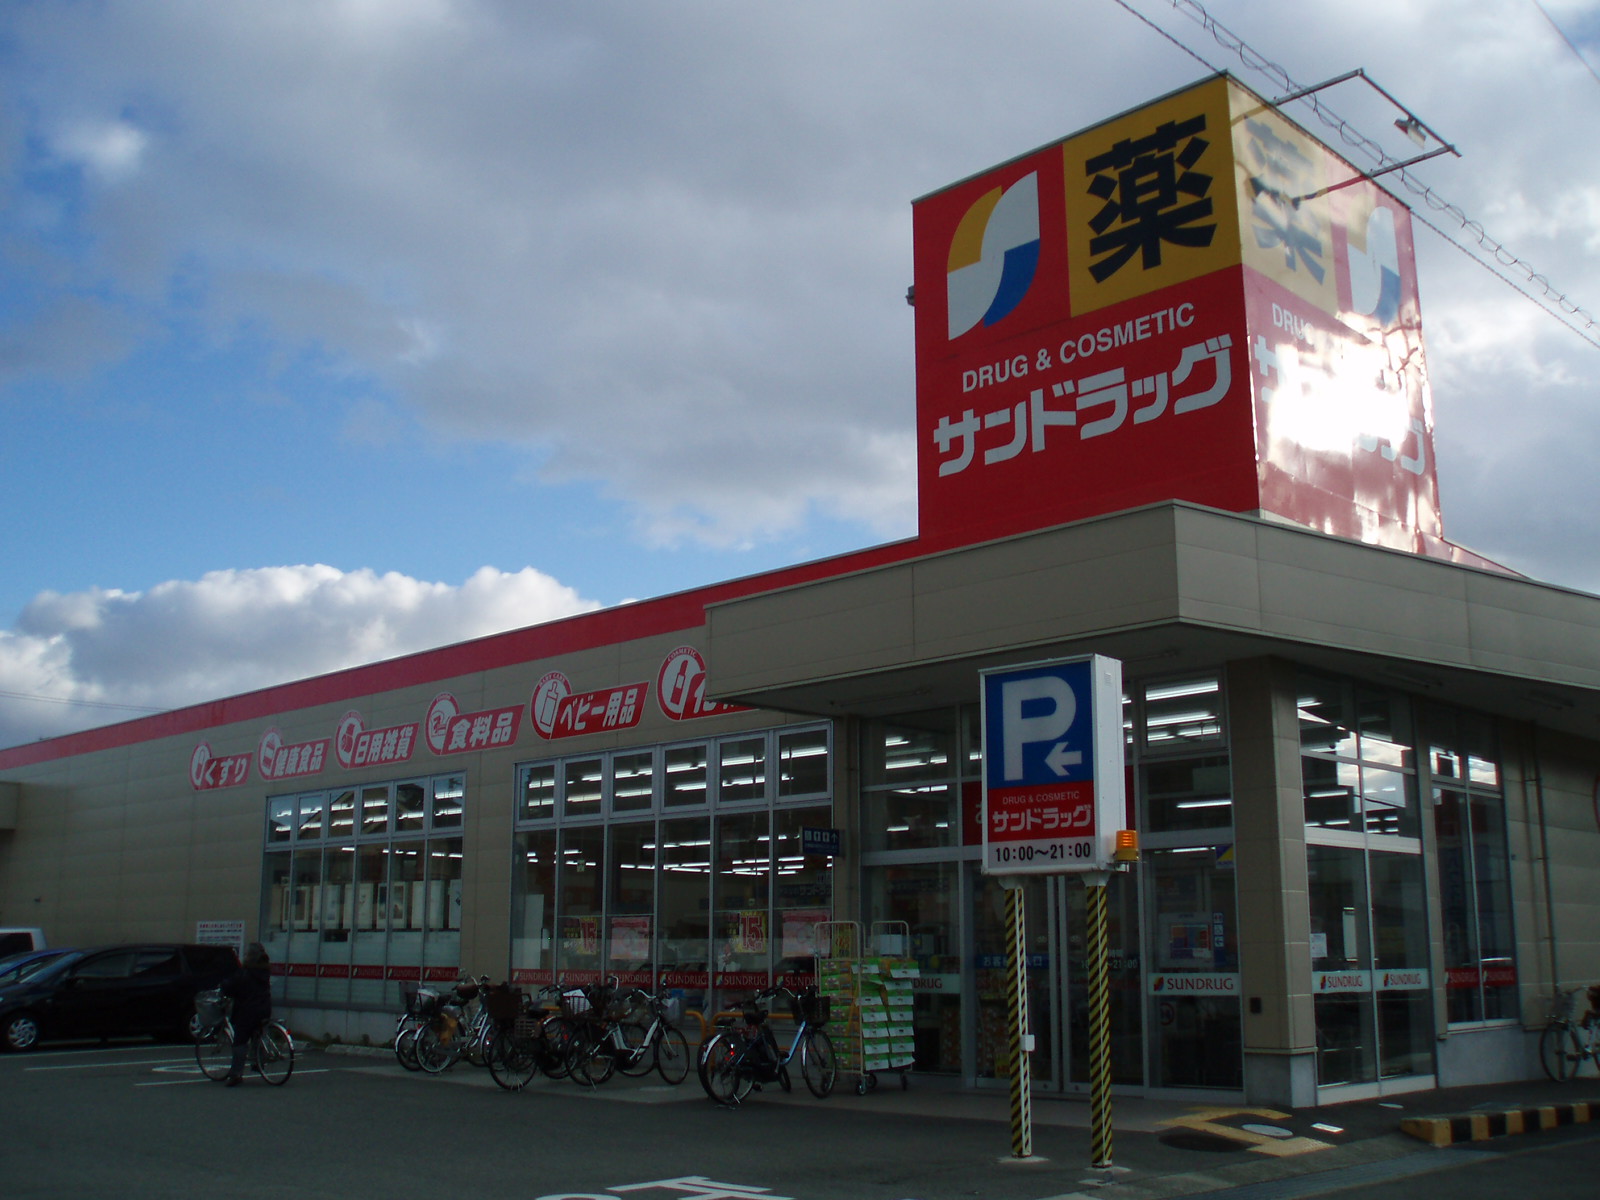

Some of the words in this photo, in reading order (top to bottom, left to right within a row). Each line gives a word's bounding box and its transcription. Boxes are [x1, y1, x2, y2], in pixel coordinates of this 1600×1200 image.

[1085, 114, 1217, 284] 薬
[962, 354, 1029, 393] DRUG
[1035, 347, 1052, 371] &
[1059, 302, 1195, 364] COSMETIC
[933, 333, 1233, 478] サンドラッグ
[560, 688, 638, 730] ベビー用品
[448, 712, 513, 750] 食料品
[1002, 675, 1077, 781] P
[355, 726, 414, 764] 日用雑貨
[205, 758, 247, 785] くすり
[274, 743, 324, 776] 健康食品
[1002, 795, 1026, 805] DRUG
[1036, 790, 1080, 802] COSMETIC
[992, 804, 1092, 833] サンドラッグ
[519, 971, 551, 982] SUNDRUG
[616, 973, 651, 984] UNDRUG
[667, 973, 708, 985] SUNDRUG
[723, 974, 767, 986] SUNDRUG
[913, 977, 943, 989] DRUG
[1167, 978, 1234, 990] SUNDRUG
[1328, 975, 1363, 988] SUNDRUG
[1390, 973, 1422, 986] SUNDRUG
